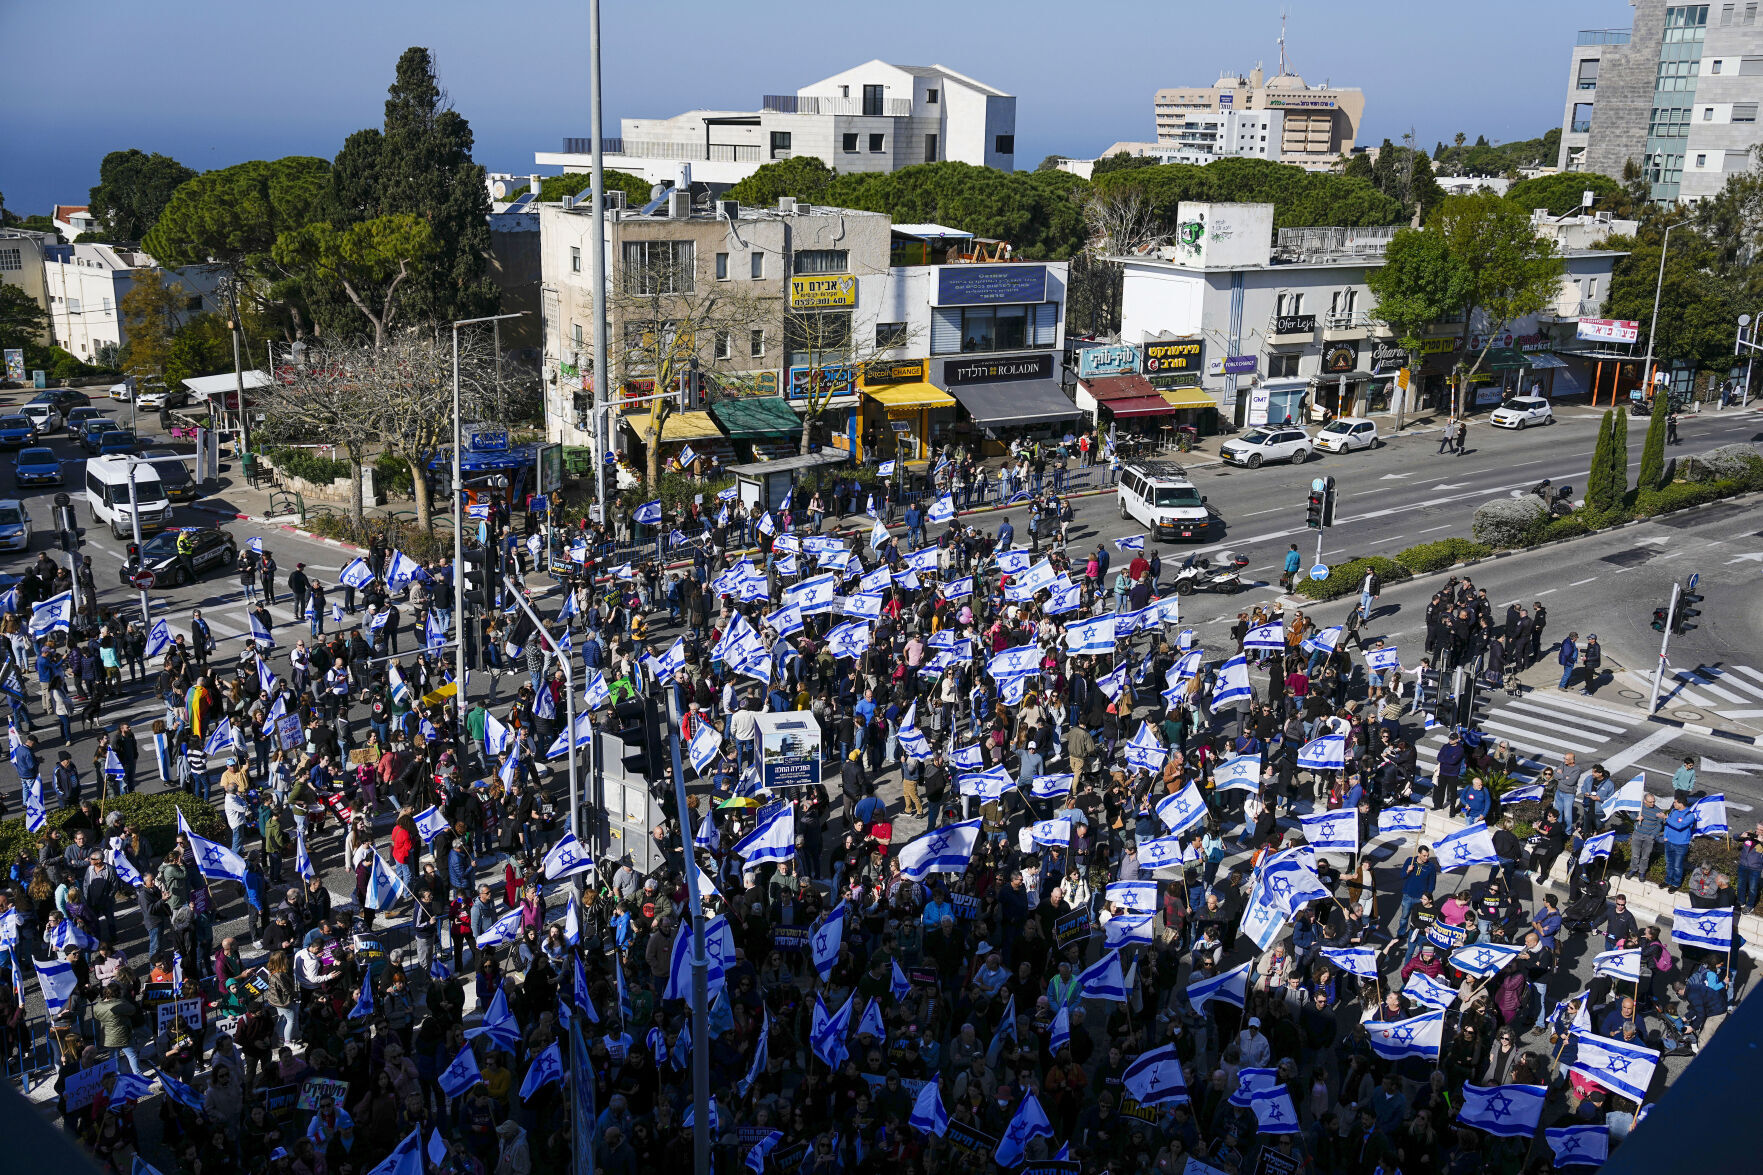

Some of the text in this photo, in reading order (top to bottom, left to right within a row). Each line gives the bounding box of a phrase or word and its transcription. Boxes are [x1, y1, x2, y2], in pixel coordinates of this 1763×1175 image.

[1278, 319, 1296, 331] Ofer
[1148, 344, 1200, 358] מינימרקט
[1522, 341, 1551, 351] market
[1160, 357, 1187, 368] חורב
[893, 367, 920, 376] CHANGE
[957, 363, 988, 380] רולדין
[998, 363, 1039, 375] ROLADIN
[1173, 374, 1196, 384] סופר
[790, 764, 811, 773] המכירה
[162, 1001, 199, 1016] דרושה
